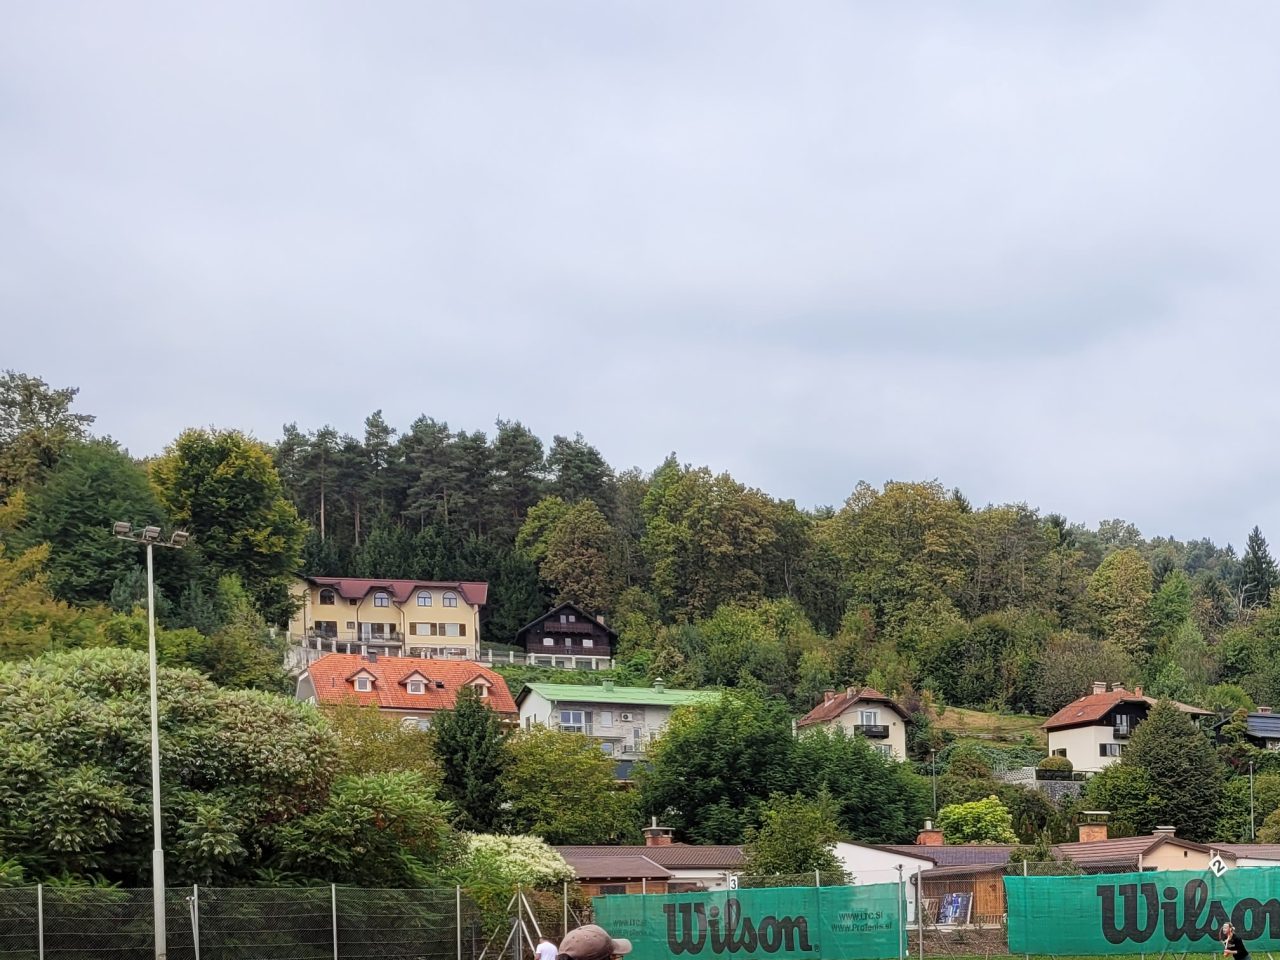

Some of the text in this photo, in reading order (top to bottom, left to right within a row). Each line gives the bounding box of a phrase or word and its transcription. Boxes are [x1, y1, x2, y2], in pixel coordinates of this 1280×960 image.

[1212, 860, 1225, 873] 2
[730, 879, 737, 890] 3
[663, 897, 812, 955] Wilson
